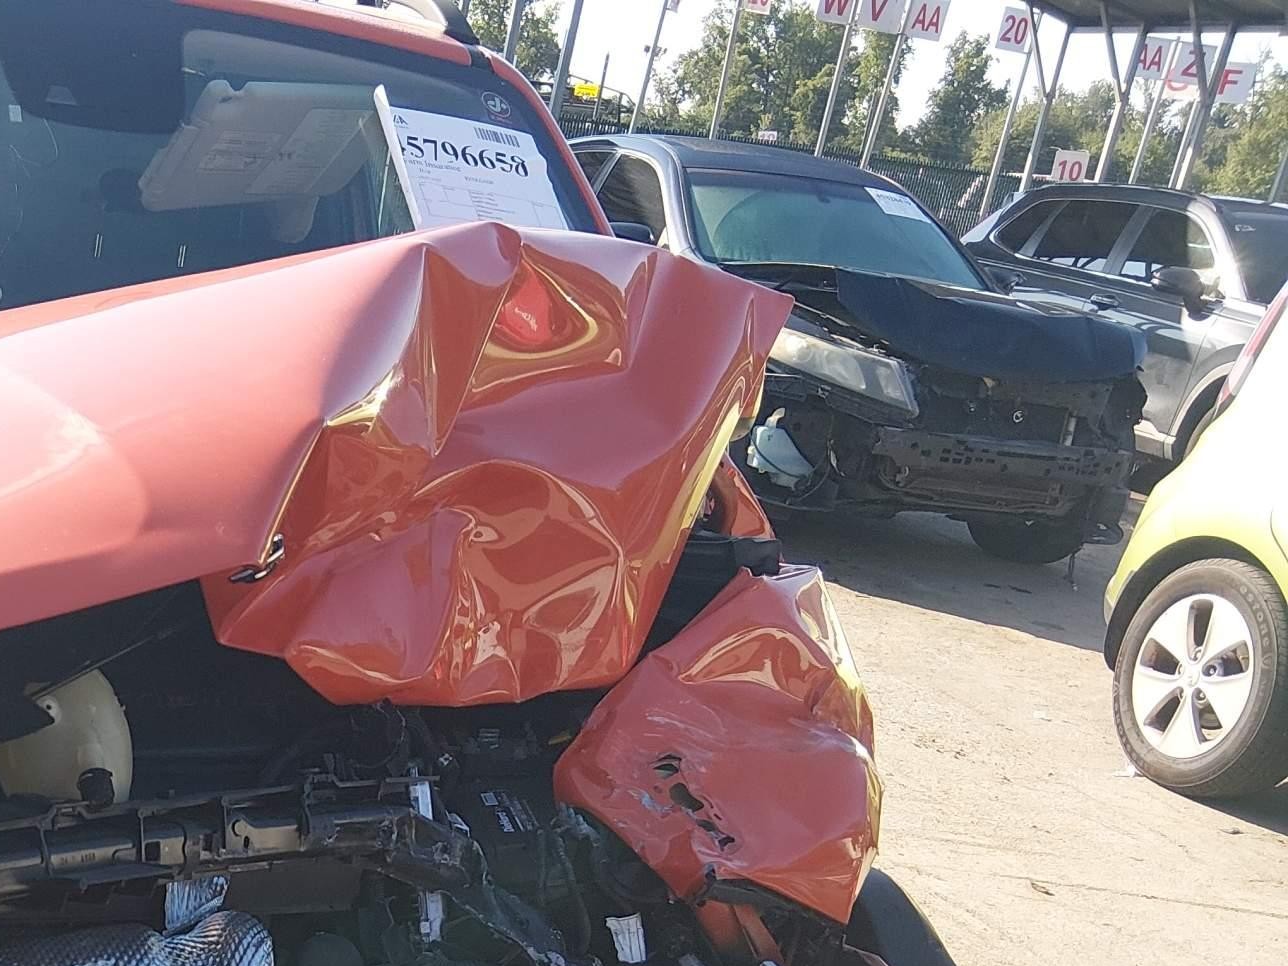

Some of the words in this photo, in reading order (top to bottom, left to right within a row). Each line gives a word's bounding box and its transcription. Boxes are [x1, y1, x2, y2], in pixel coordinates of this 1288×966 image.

[912, 3, 942, 34] AA
[999, 14, 1029, 45] 20
[1218, 68, 1244, 96] F
[1058, 159, 1083, 182] 10
